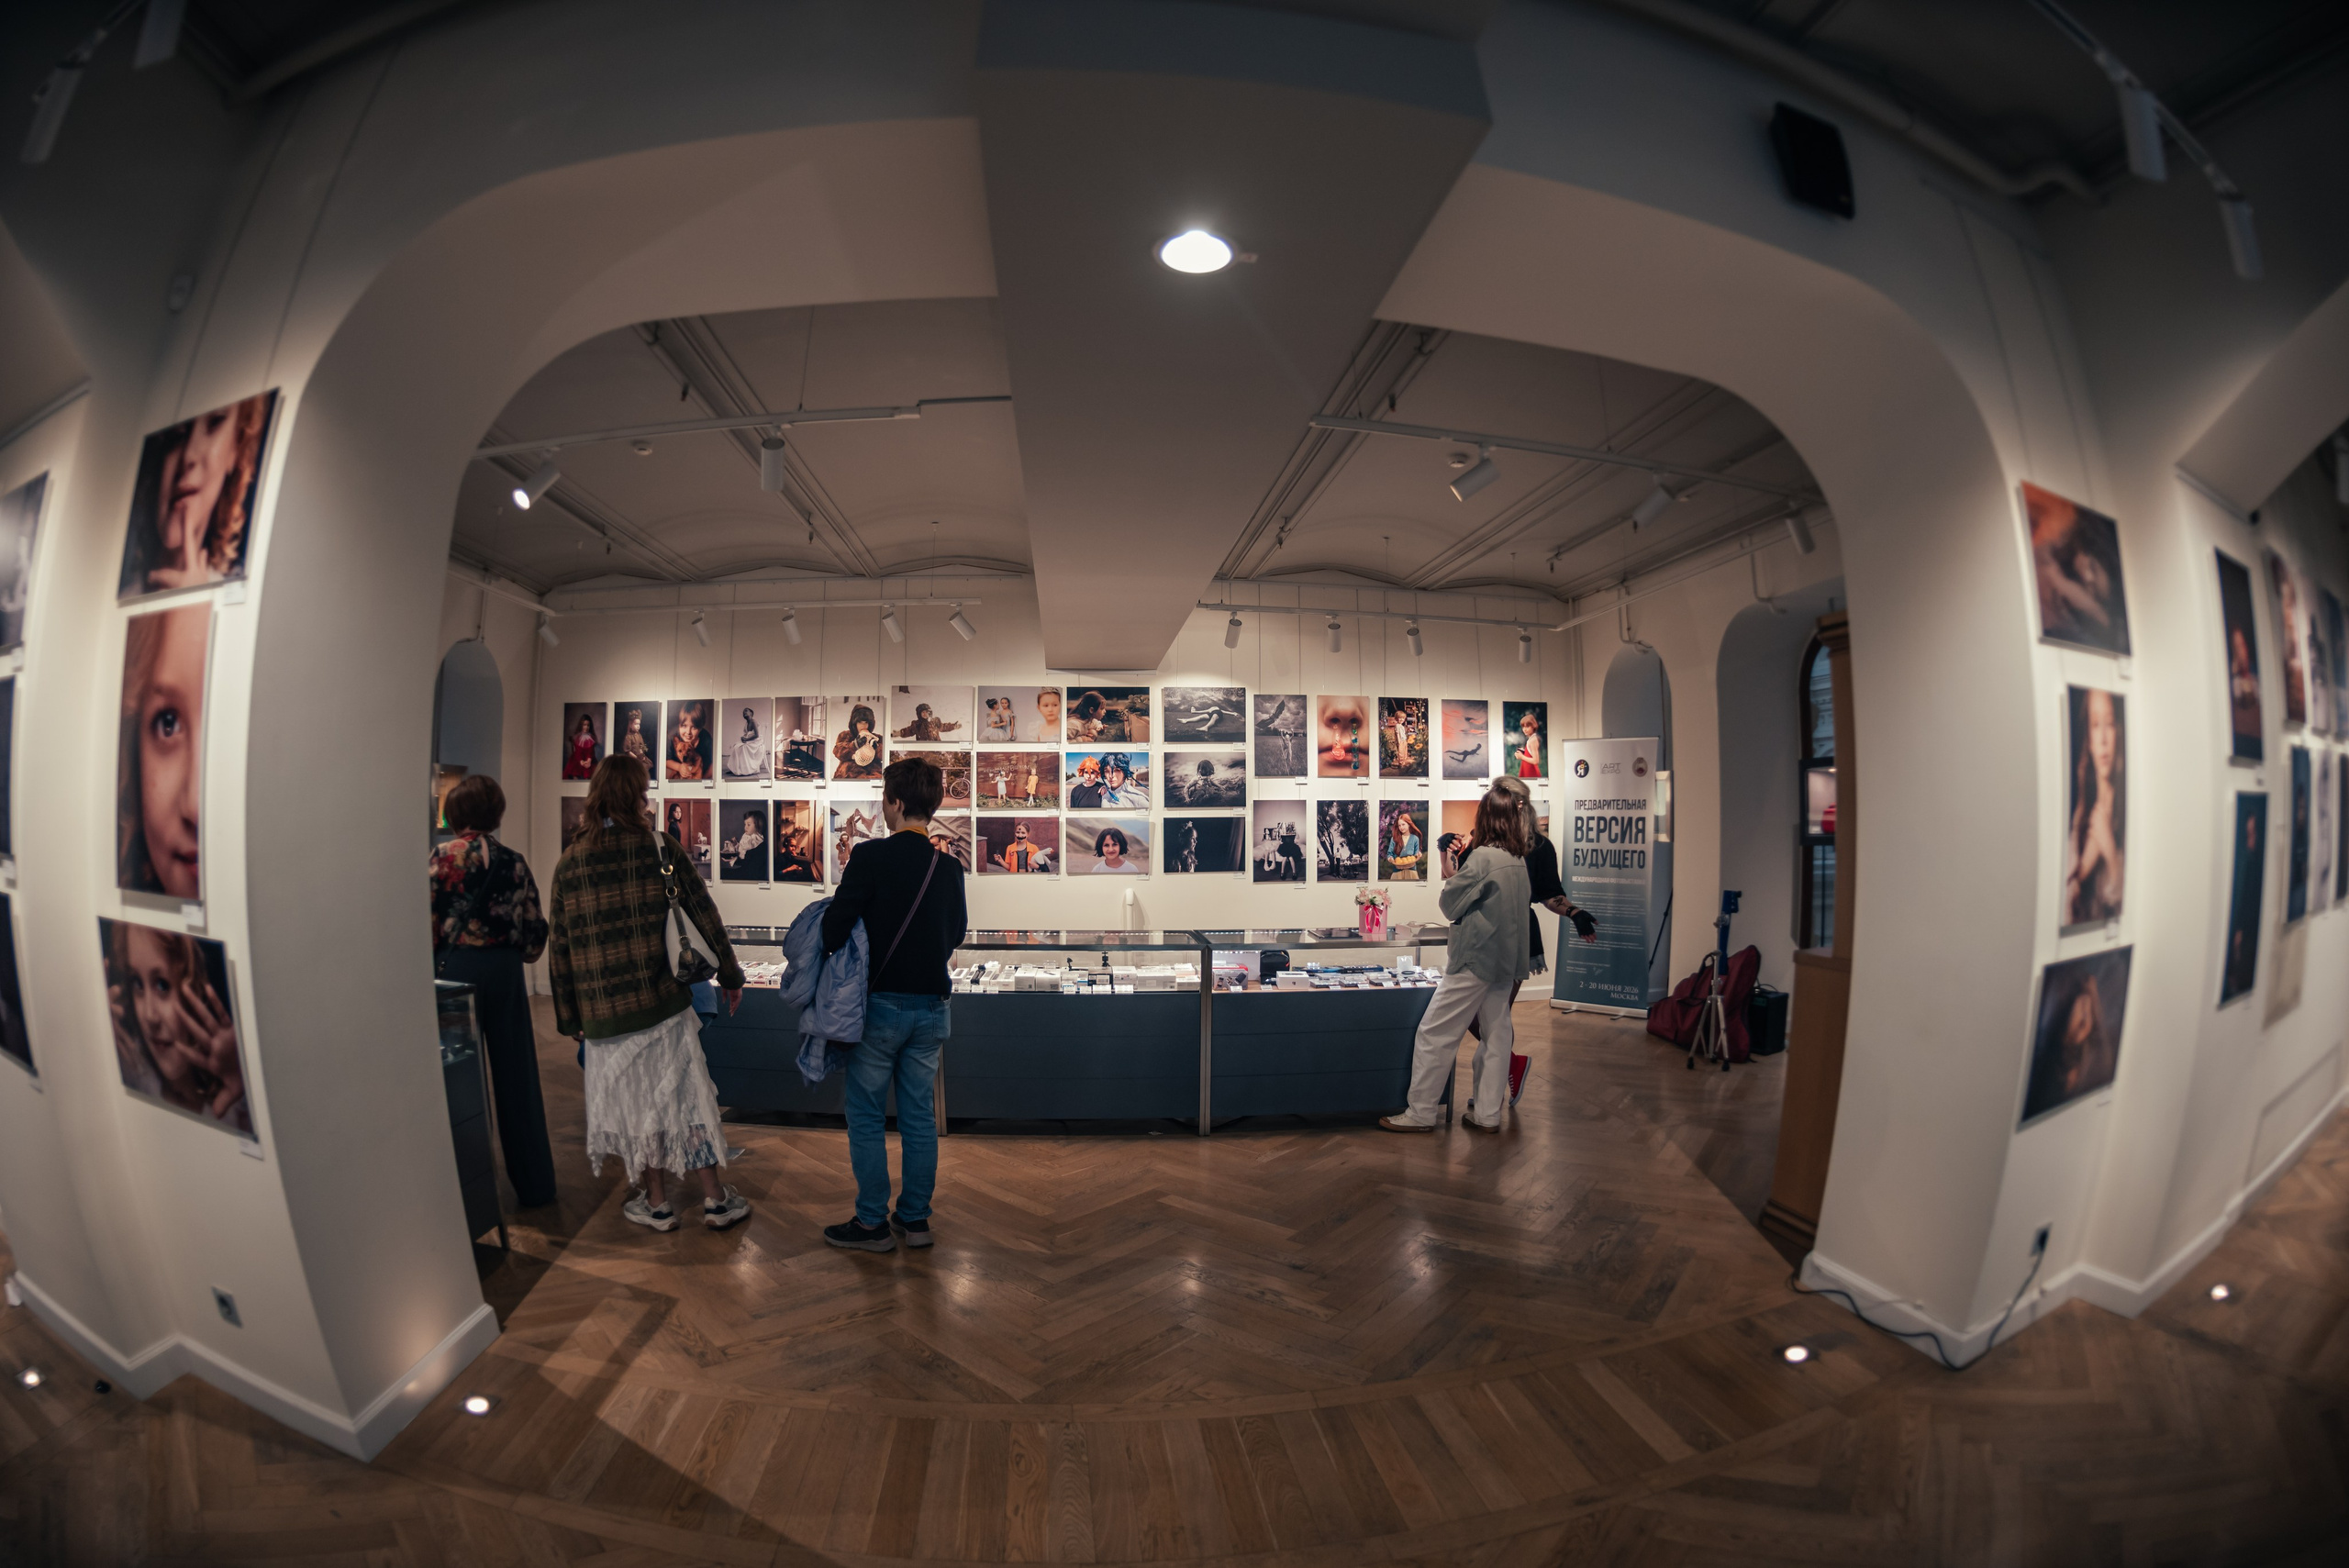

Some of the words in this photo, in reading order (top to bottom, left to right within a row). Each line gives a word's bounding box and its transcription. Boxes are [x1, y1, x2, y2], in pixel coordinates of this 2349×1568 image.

[1575, 799, 1646, 811] ПРЕДВАРИТЕЛЬНАЯ
[1574, 816, 1646, 844] ВЕРСИЯ
[1573, 848, 1646, 870] БУДУЩЕГО
[1598, 983, 1622, 992] ИЮНЯ
